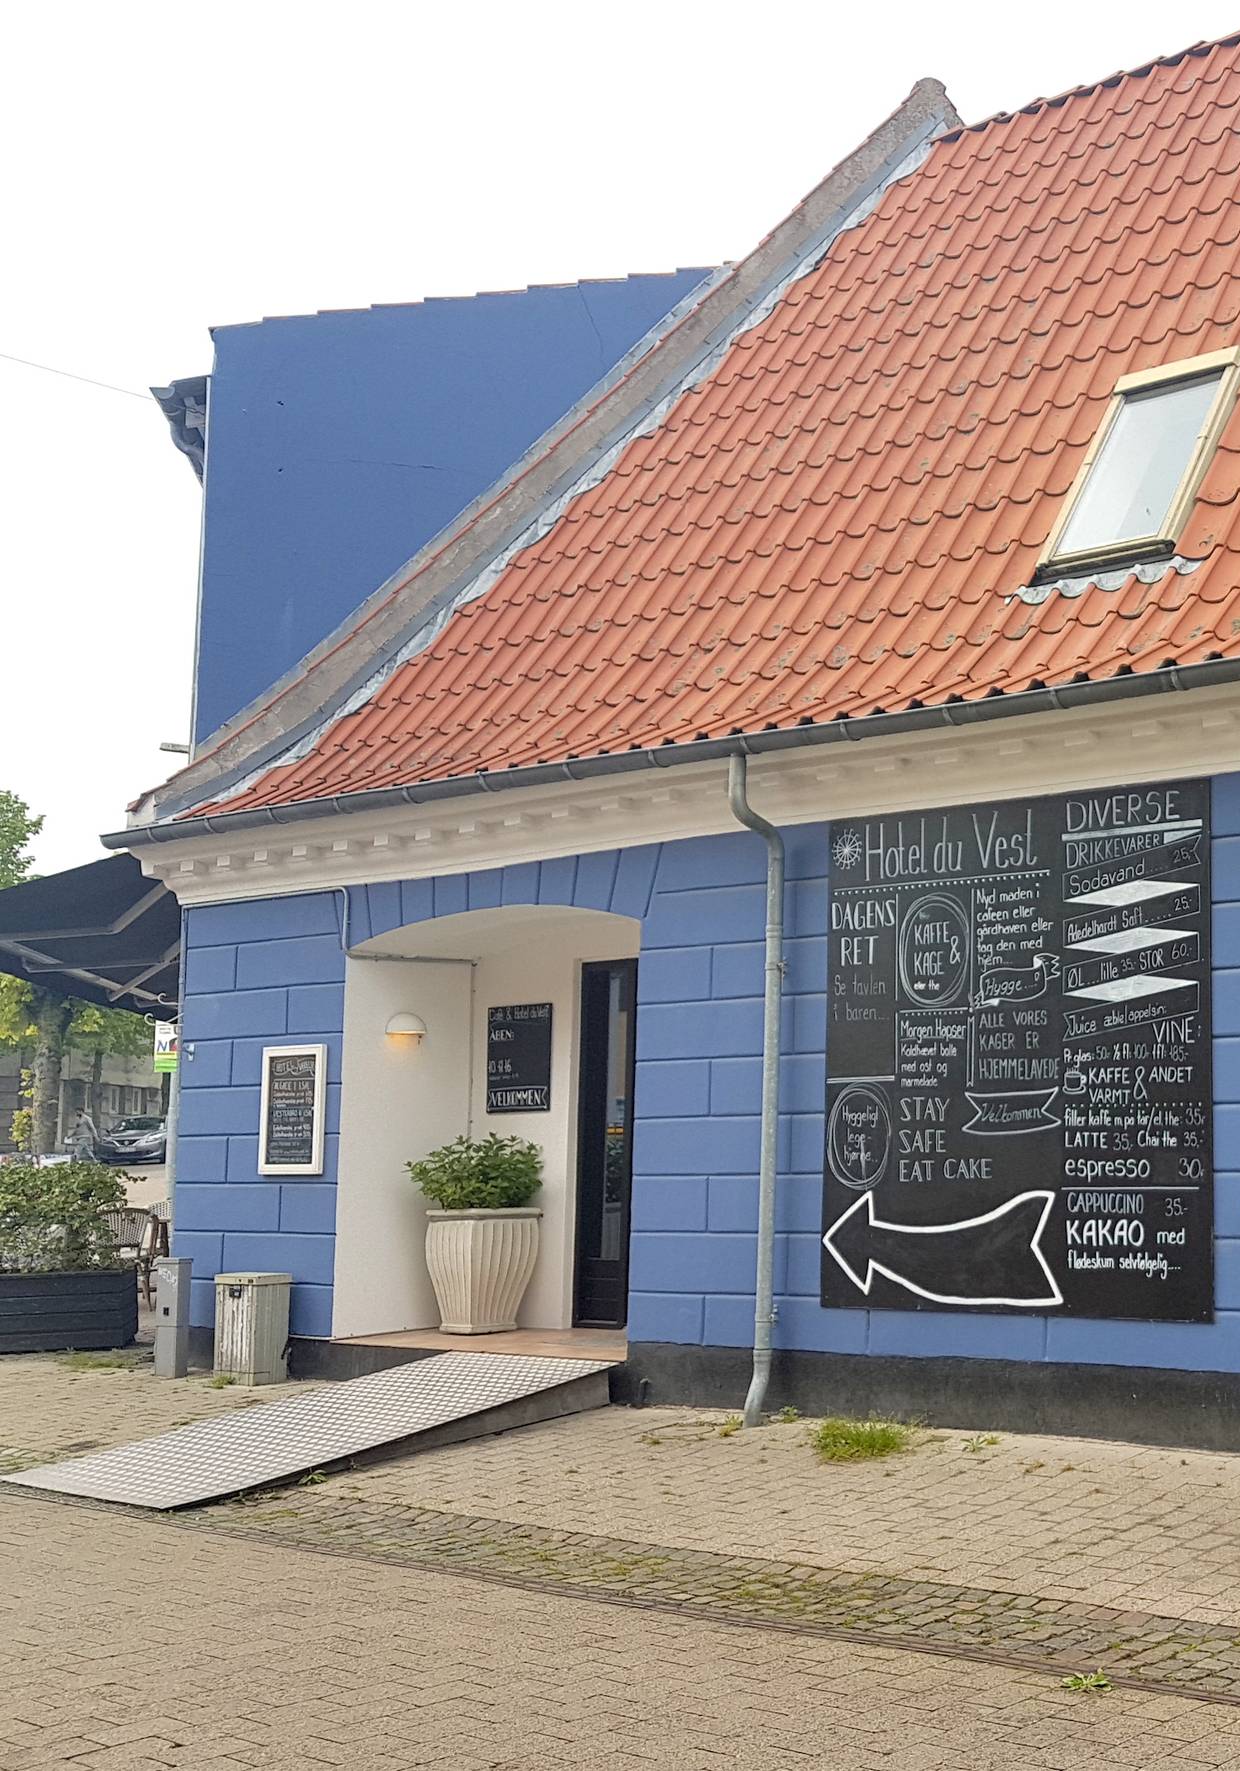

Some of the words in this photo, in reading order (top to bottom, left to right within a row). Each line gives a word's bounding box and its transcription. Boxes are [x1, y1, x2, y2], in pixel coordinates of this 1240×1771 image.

[1066, 790, 1181, 833] DIVERSE
[864, 817, 928, 882] Hotel
[933, 815, 963, 873] du
[971, 808, 1038, 869] Vest
[1066, 833, 1160, 869] DRIKKEVARER
[1069, 858, 1146, 895] Sodavand
[977, 888, 996, 909] Nyd
[999, 887, 1033, 903] maden
[1035, 882, 1040, 898] i
[831, 900, 895, 930] DAGENS
[1012, 905, 1036, 919] eller
[976, 922, 1027, 941] gårdhaven
[1031, 917, 1054, 932] eller
[840, 935, 879, 967] RET
[914, 921, 950, 946] KAFFE
[949, 935, 961, 965] &
[977, 940, 993, 958] tag
[996, 939, 1016, 951] den
[1020, 935, 1043, 950] med
[913, 951, 945, 976] KAGE
[1100, 961, 1119, 981] lille
[1139, 948, 1165, 970] STOR
[834, 974, 847, 996] Se
[852, 973, 887, 996] tavlen
[900, 1019, 933, 1043] Morgen
[935, 1018, 967, 1042] Hapser
[979, 1012, 1005, 1029] ALLE
[1012, 1010, 1047, 1026] VORES
[1067, 1014, 1097, 1036] Juice
[940, 1042, 957, 1057] bolle
[979, 1032, 1016, 1052] KAGER
[1025, 1031, 1040, 1049] ER
[901, 1060, 917, 1073] med
[919, 1058, 932, 1073] ost
[936, 1062, 948, 1078] og
[978, 1058, 1060, 1080] HJEMMELAVEDE
[900, 1073, 938, 1088] marmelade
[1088, 1067, 1130, 1084] KAFFE
[1133, 1066, 1148, 1100] &
[1148, 1066, 1193, 1082] ANDET
[491, 1089, 541, 1107] VELKOMMEN
[1088, 1088, 1131, 1104] VARMT
[842, 1104, 879, 1128] Hyggeligt
[899, 1097, 950, 1122] STAY
[981, 1102, 1042, 1123] Velkommen
[1088, 1109, 1112, 1126] kaffe
[898, 1129, 946, 1154] SAFE
[1065, 1131, 1108, 1149] LATTE
[1137, 1130, 1160, 1147] Chai
[1161, 1130, 1177, 1148] the
[899, 1159, 935, 1182] EAT
[943, 1158, 993, 1180] CAKE
[1064, 1159, 1151, 1183] espresso
[1067, 1191, 1144, 1215] CAPPUCCINO
[1066, 1219, 1145, 1247] KAKAO
[1156, 1227, 1186, 1245] med
[1067, 1249, 1115, 1269] flødeskum
